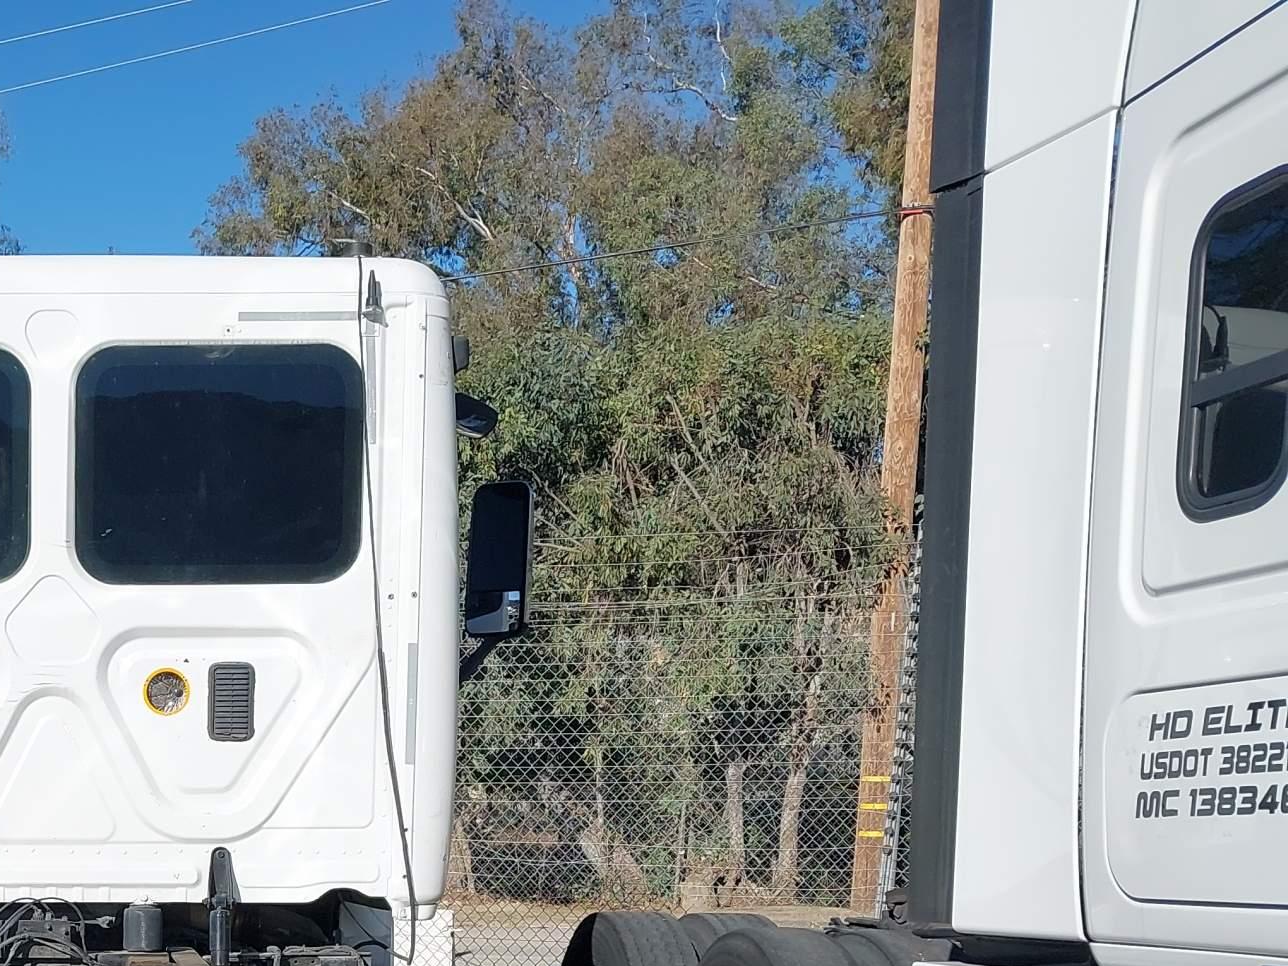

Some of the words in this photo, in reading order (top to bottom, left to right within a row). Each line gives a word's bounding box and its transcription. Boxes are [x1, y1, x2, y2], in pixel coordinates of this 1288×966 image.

[1149, 710, 1193, 741] HD
[1202, 699, 1288, 736] ELIT
[1140, 747, 1213, 780] USDOT
[1219, 742, 1288, 775] 3822
[1136, 790, 1180, 818] MC
